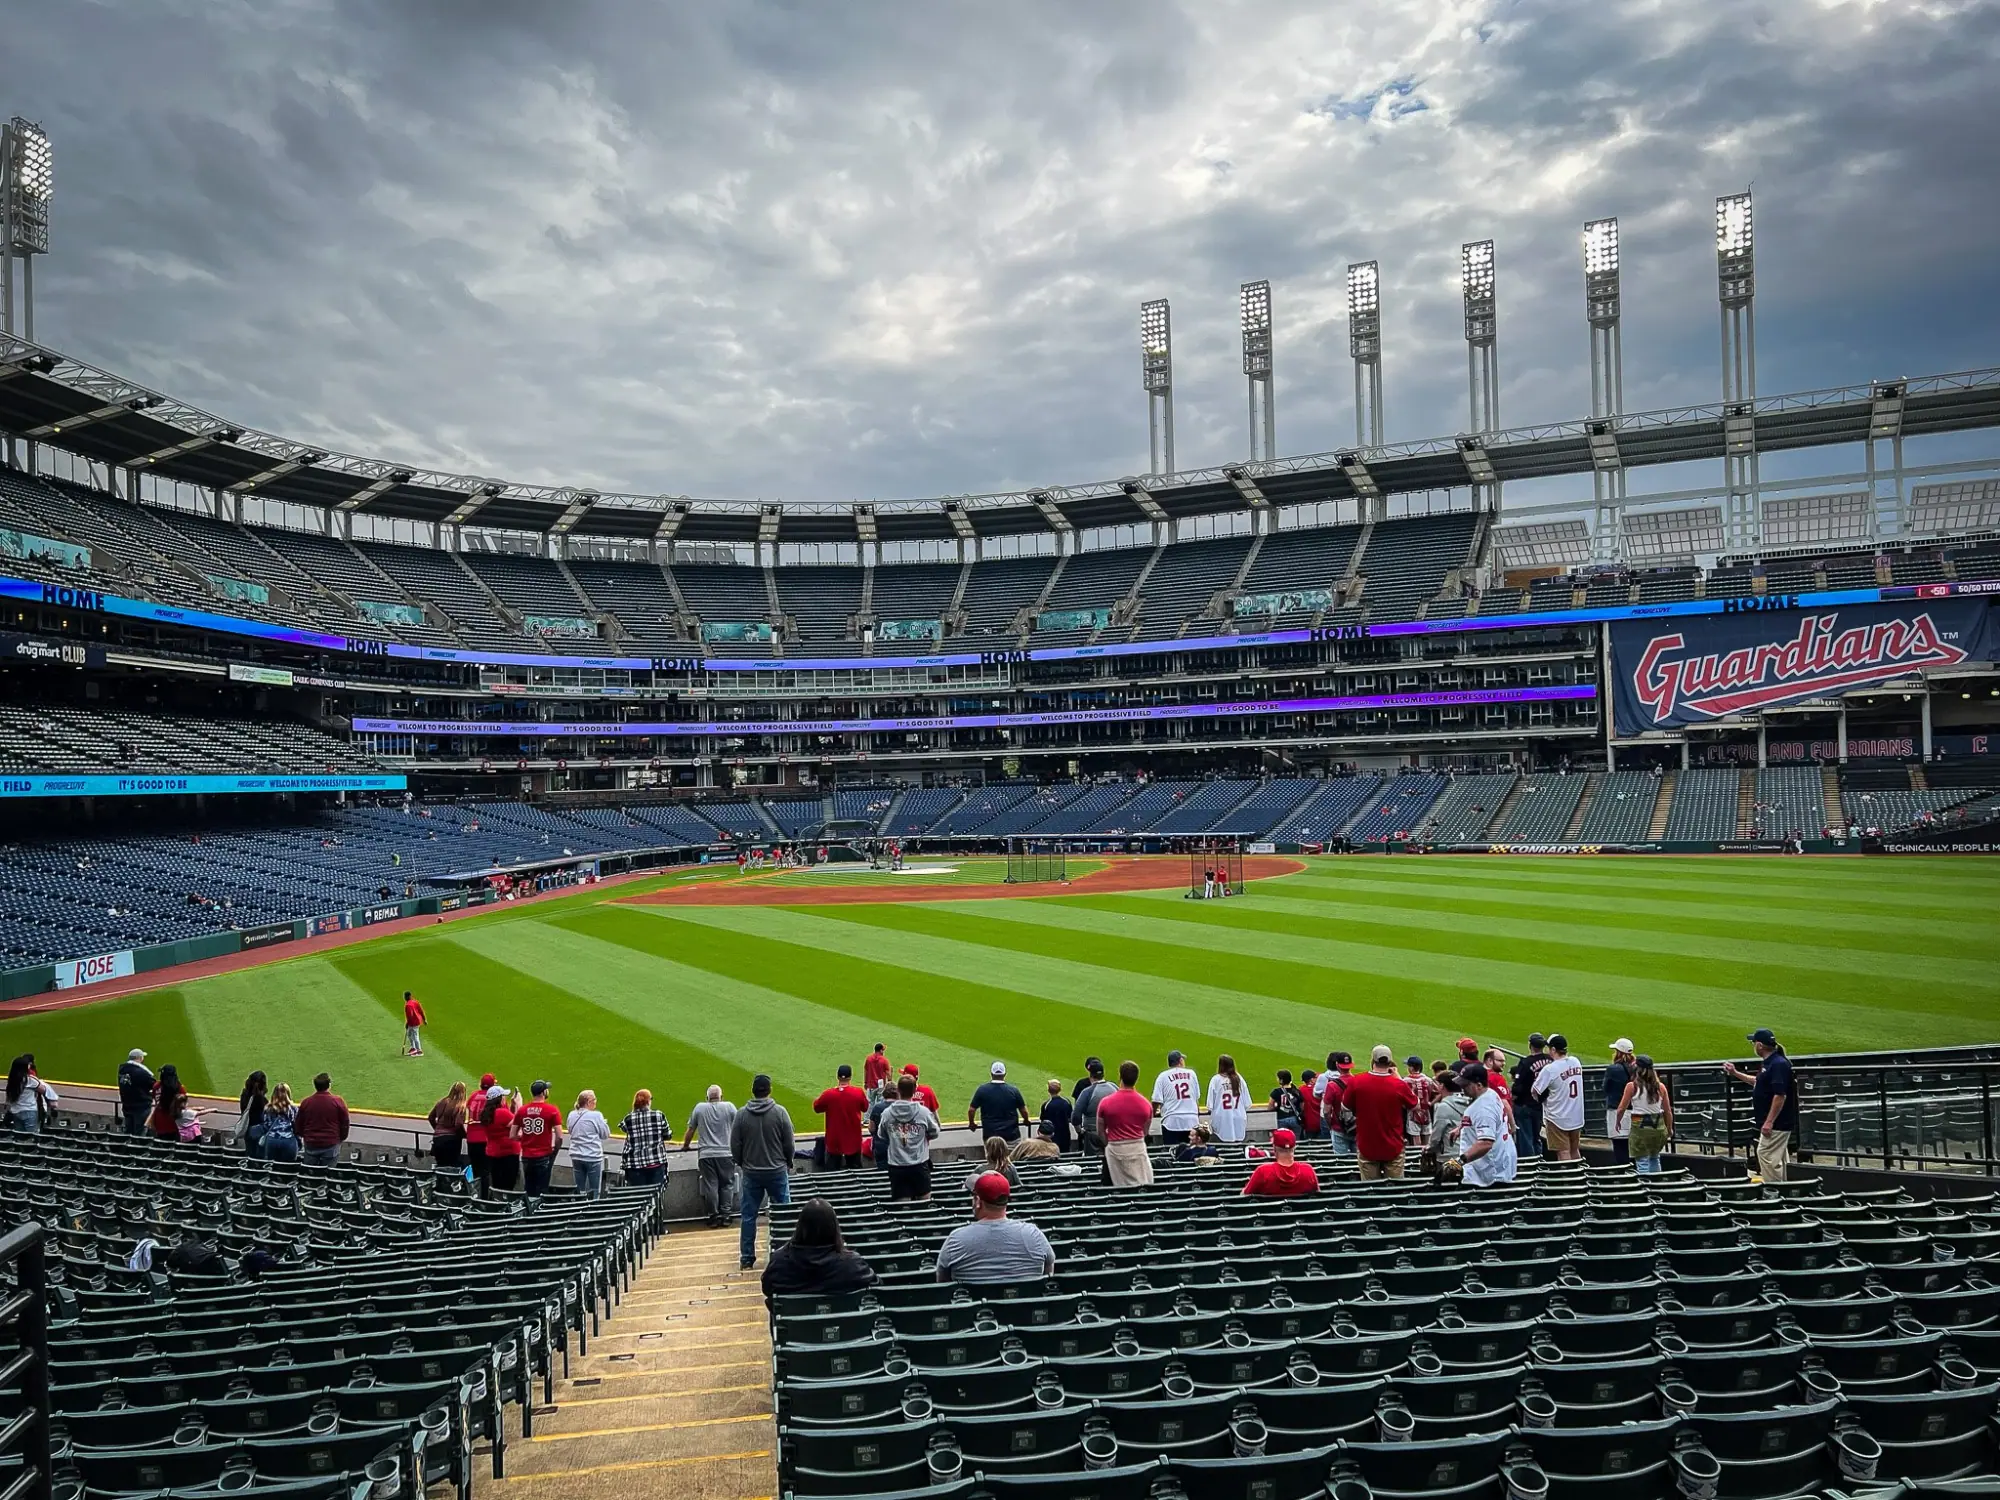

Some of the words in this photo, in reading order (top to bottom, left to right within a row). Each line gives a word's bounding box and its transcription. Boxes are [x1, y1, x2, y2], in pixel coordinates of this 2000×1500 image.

[1958, 584, 1981, 593] 50/50
[42, 584, 105, 612] HOME
[1724, 594, 1800, 612] HOME
[1311, 626, 1370, 644] HOME
[16, 643, 38, 658] drug
[38, 648, 60, 658] mart
[62, 646, 86, 664] CLUB
[347, 638, 388, 656] HOME
[652, 658, 706, 672] HOME
[982, 650, 1032, 665] HOME
[1634, 612, 1968, 723] Guardians
[1942, 632, 1959, 640] TM
[1382, 697, 1422, 705] WELCOME
[1438, 692, 1496, 702] PROGRESSIVE
[1499, 691, 1522, 699] FIELD
[1084, 711, 1131, 719] PROGRESSIVE
[1707, 742, 1803, 761] CLEVEAND
[1972, 736, 1988, 754] C
[4, 781, 32, 792] FIELD
[118, 780, 135, 790] IT'S
[138, 780, 164, 790] GOOD
[166, 780, 176, 790] TO
[178, 779, 188, 789] BE
[270, 780, 300, 788] WELCOME
[310, 780, 348, 788] PROGRESSIVE
[348, 779, 362, 787] FIELD
[1510, 845, 1579, 854] CONRAD'S
[1883, 844, 1950, 853] TECHNICALLY,
[1952, 844, 1990, 852] PEOPLE
[374, 906, 399, 921] RE/MAX
[75, 955, 115, 986] ROSE
[1168, 1072, 1190, 1082] LINDOR
[1174, 1082, 1191, 1100] 12
[1568, 1080, 1578, 1099] 0
[522, 1117, 544, 1134] 38
